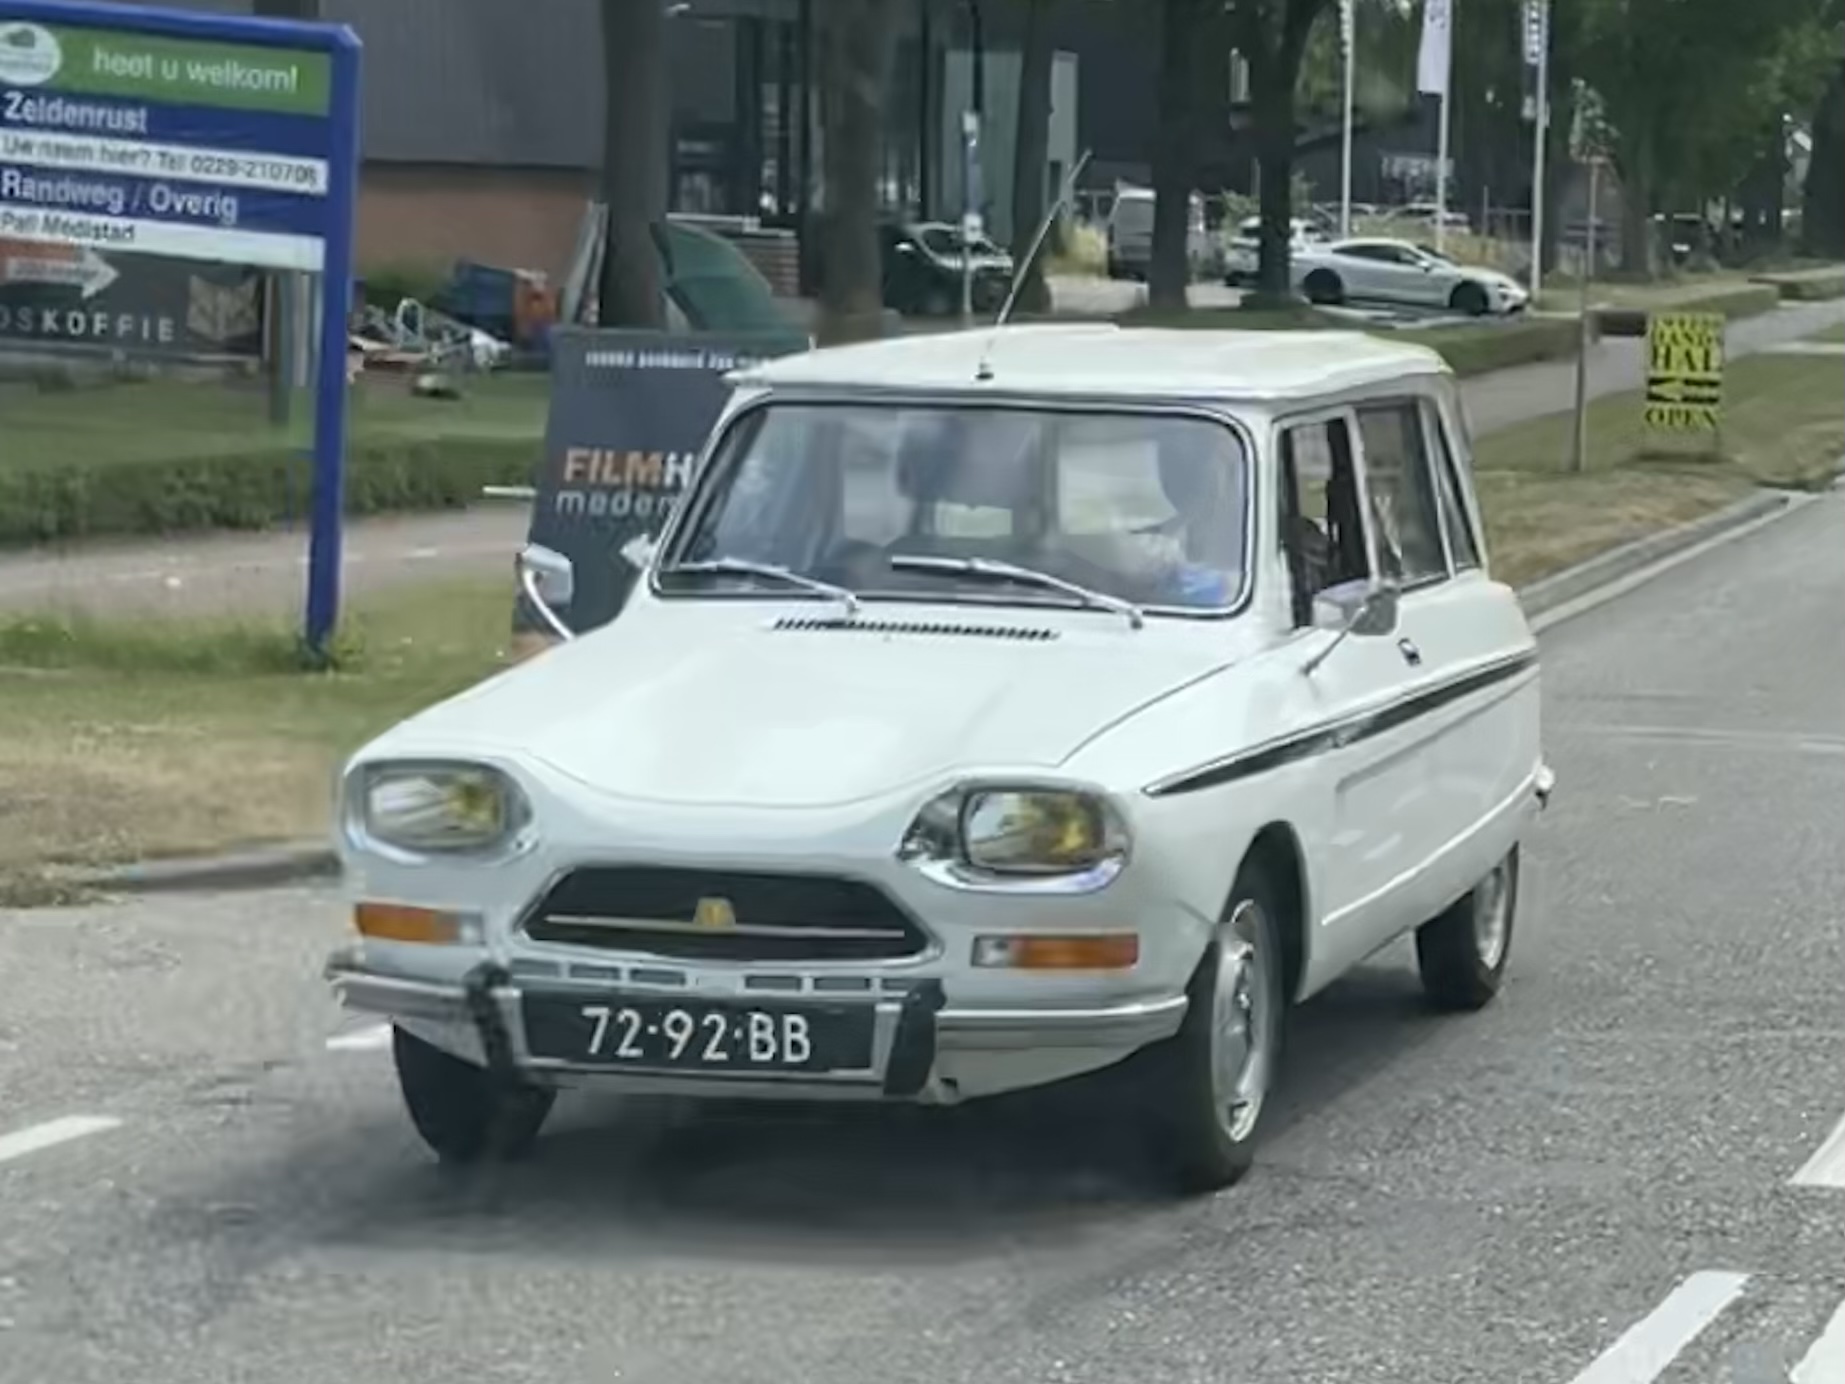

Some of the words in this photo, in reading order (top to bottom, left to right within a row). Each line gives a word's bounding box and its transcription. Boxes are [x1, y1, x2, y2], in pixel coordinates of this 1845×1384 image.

[93, 47, 153, 80] heet
[161, 59, 179, 81] u
[187, 60, 298, 94] welkom!
[3, 89, 149, 134] Zeldenrust
[1, 168, 125, 214] Randweg
[150, 182, 239, 227] Overig
